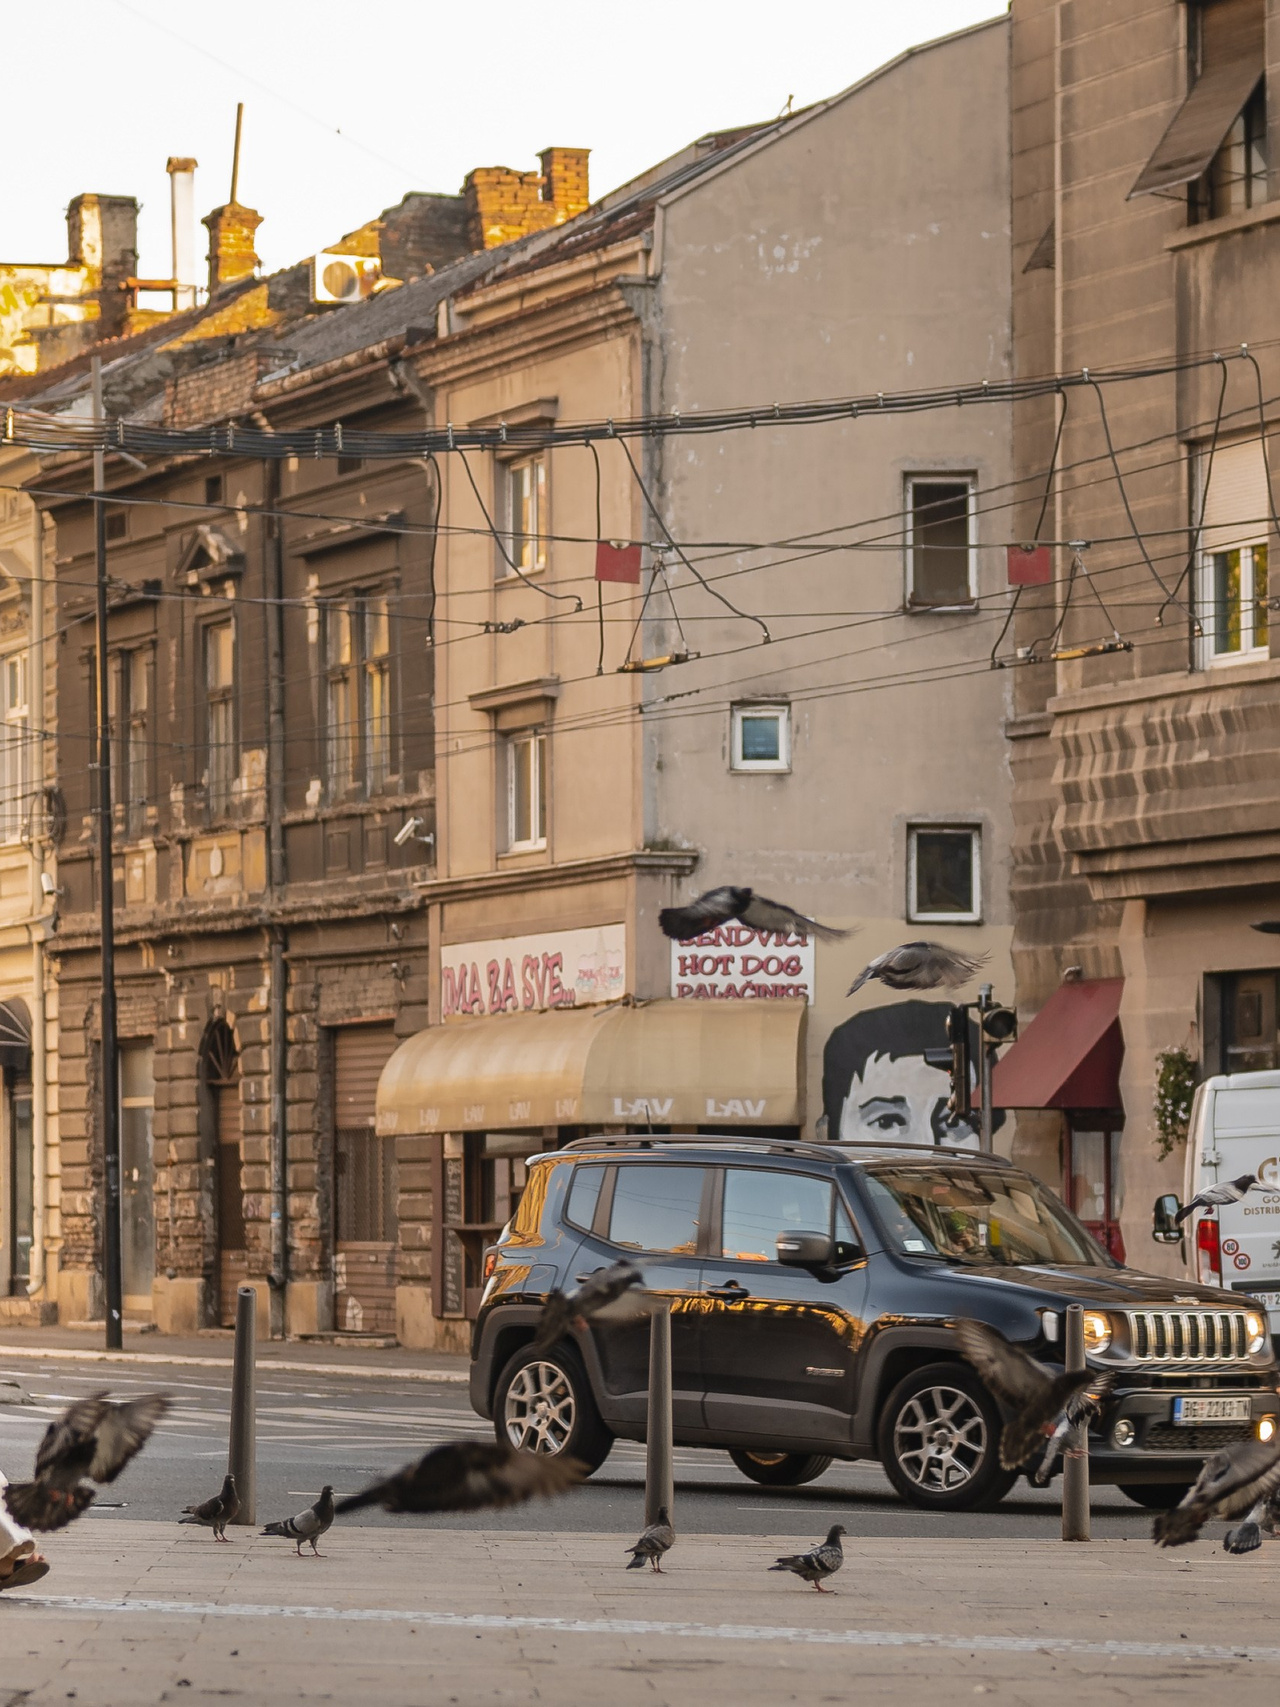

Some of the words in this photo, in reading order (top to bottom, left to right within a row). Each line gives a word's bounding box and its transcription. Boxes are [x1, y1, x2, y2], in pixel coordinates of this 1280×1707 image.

[677, 954, 735, 977] HOT
[739, 954, 803, 977] DOG
[464, 1105, 485, 1123] LAV
[509, 1101, 531, 1120] LAV
[555, 1099, 578, 1118] LAV
[613, 1097, 674, 1116] LAV
[705, 1098, 767, 1118] LAV
[1258, 1157, 1280, 1184] G
[1226, 1243, 1235, 1252] 80
